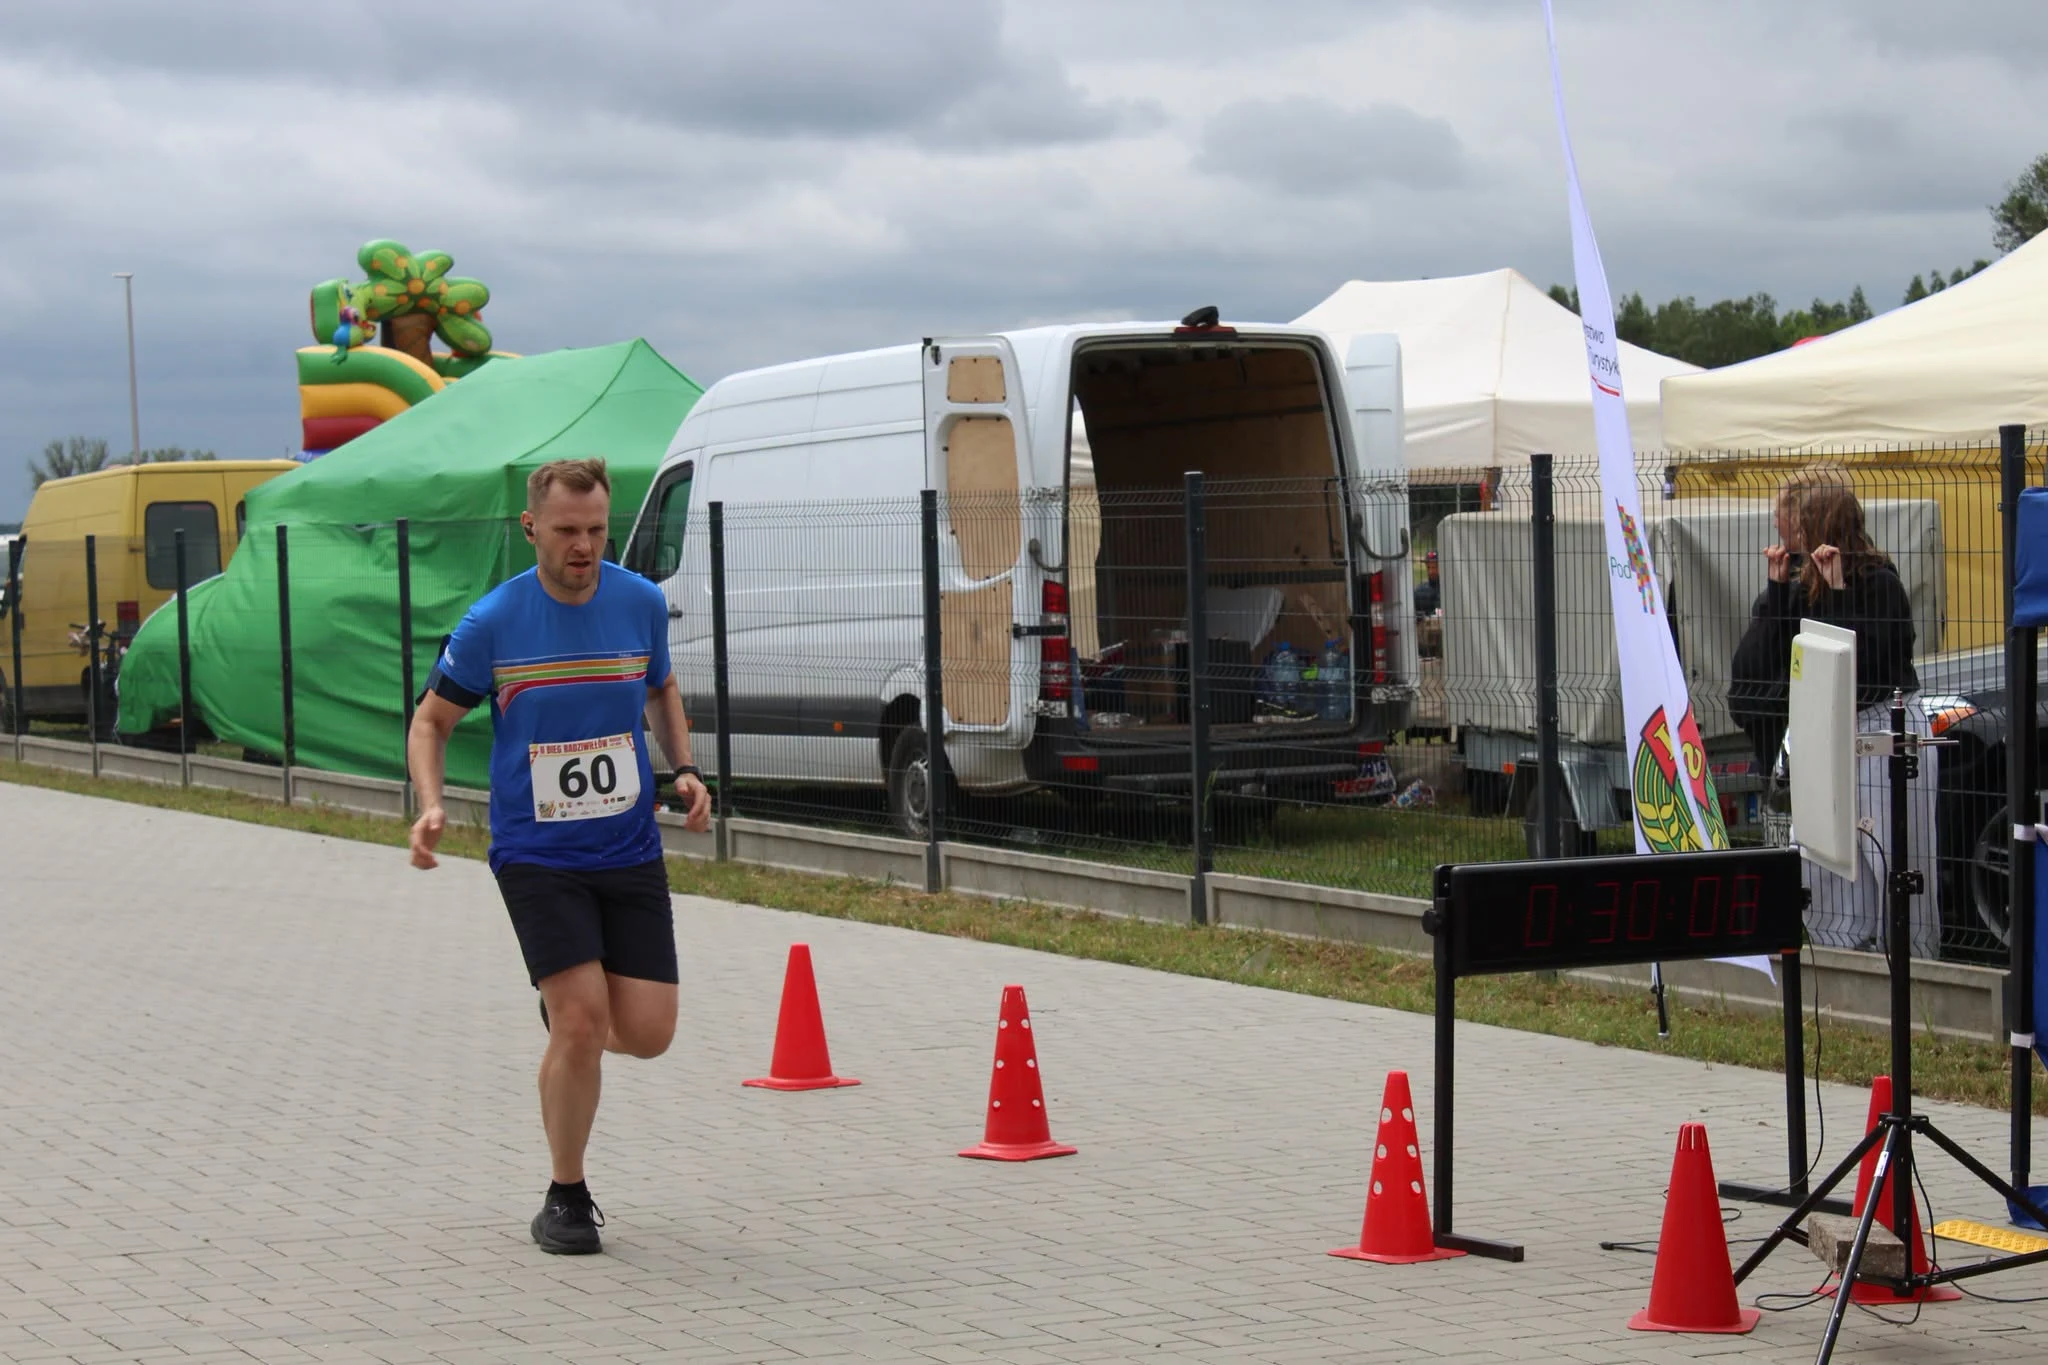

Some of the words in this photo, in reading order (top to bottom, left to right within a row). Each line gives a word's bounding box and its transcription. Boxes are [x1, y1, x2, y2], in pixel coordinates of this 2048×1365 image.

[1610, 556, 1632, 579] Pod
[546, 744, 562, 754] BIEG
[559, 754, 617, 798] 60
[1525, 875, 1762, 946] 0:30:08
